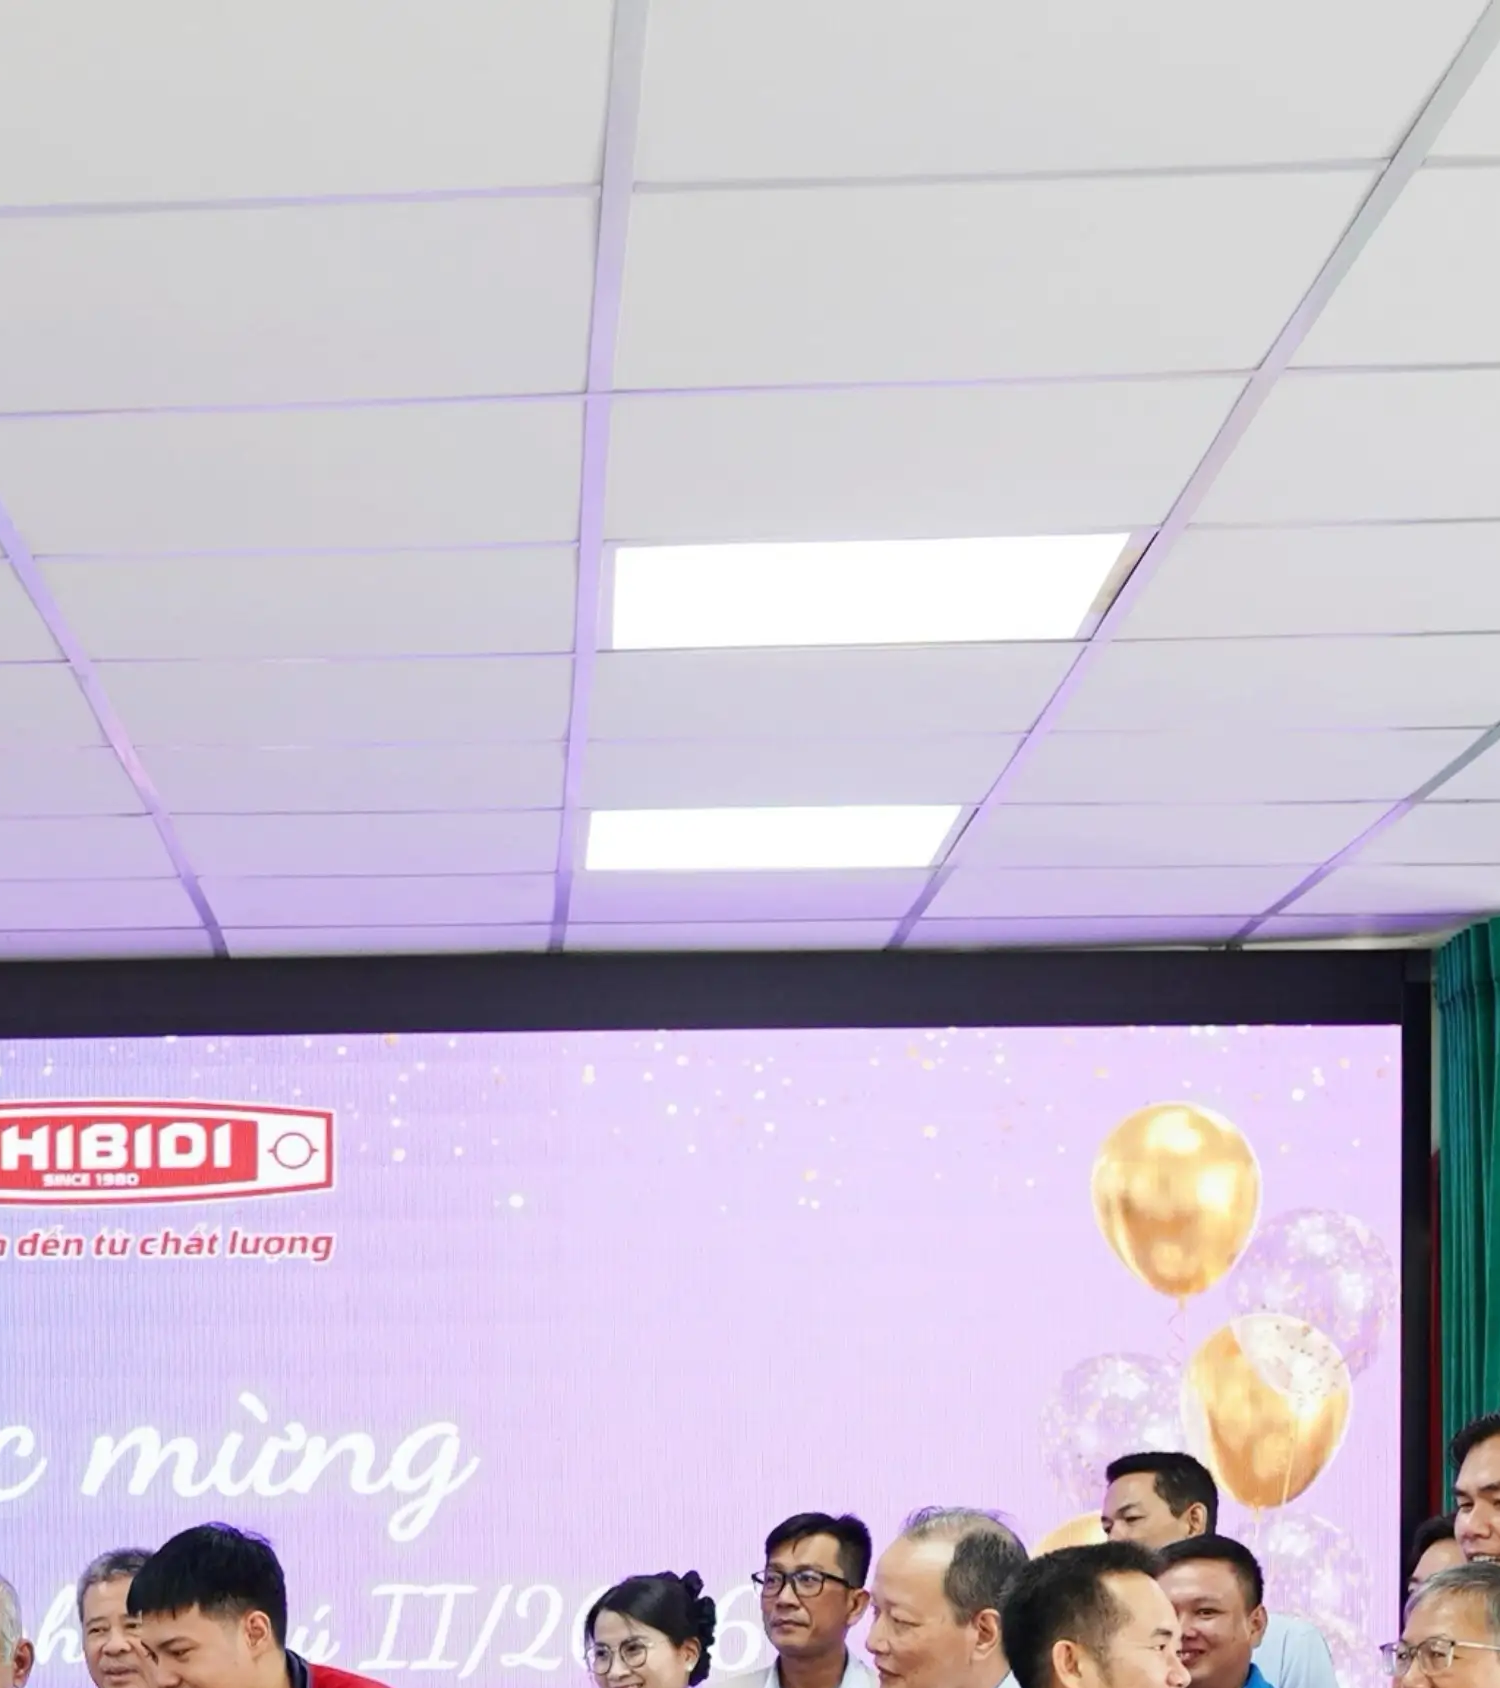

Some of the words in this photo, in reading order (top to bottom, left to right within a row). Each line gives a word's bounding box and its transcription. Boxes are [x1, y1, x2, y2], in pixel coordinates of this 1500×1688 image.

[42, 1172, 91, 1187] SINCE
[96, 1172, 140, 1187] 1980
[17, 1224, 83, 1258] đến
[138, 1223, 220, 1258] chất
[228, 1228, 334, 1263] lượng
[79, 1390, 481, 1542] mừng
